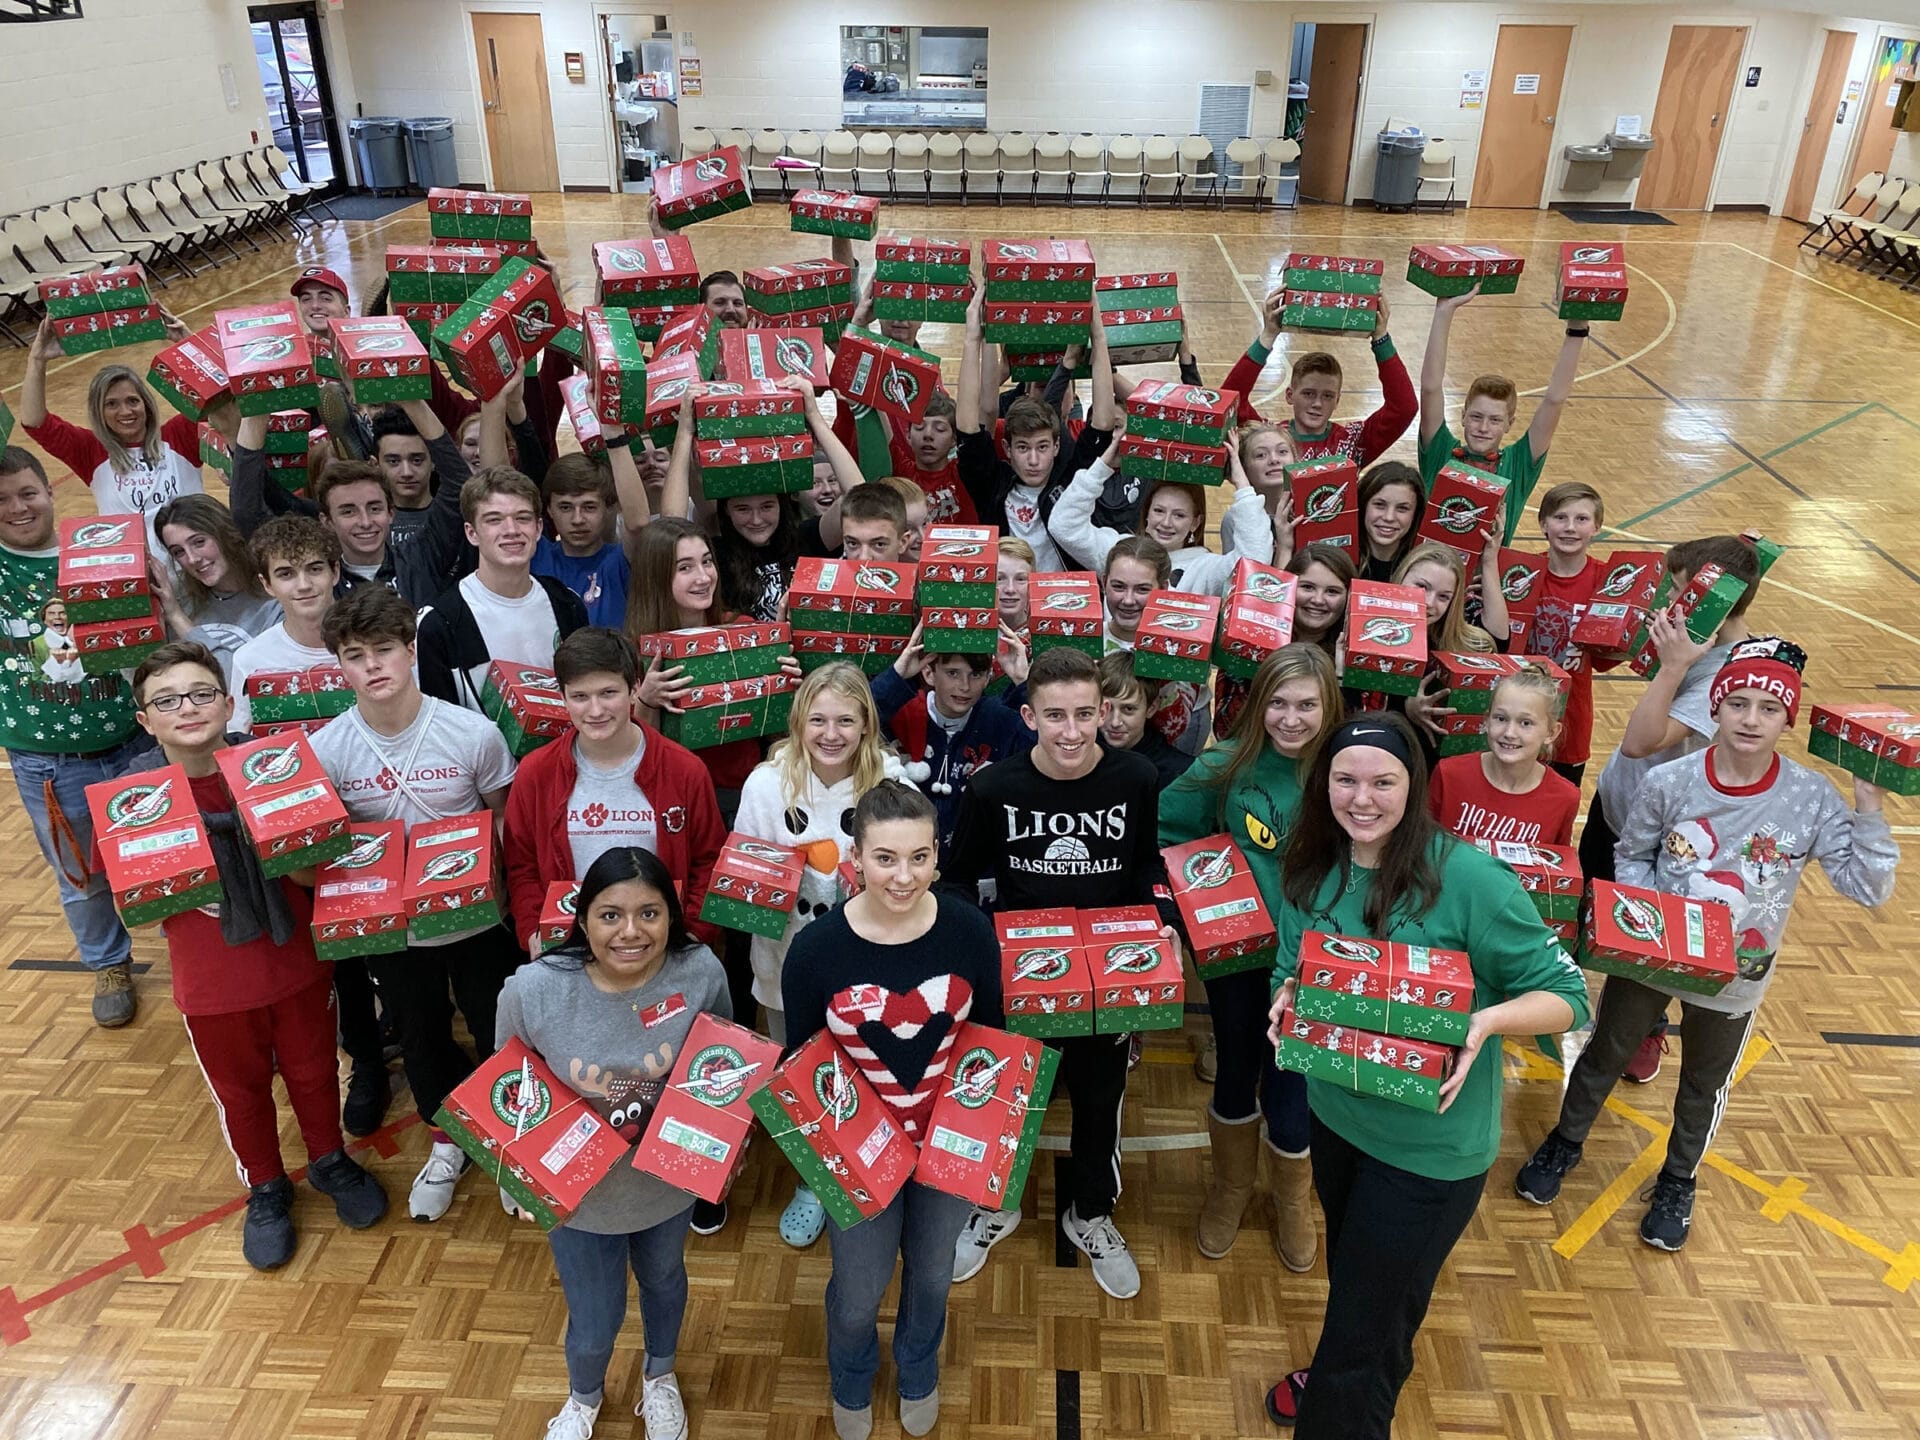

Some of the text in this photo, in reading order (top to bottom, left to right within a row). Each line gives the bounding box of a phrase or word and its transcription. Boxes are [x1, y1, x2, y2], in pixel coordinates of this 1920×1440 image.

[1711, 673, 1795, 711] CAT-MAS
[406, 767, 459, 781] LIONS
[1003, 801, 1127, 842] LIONS
[1008, 854, 1122, 876] BASKETBALL
[350, 881, 369, 891] Girl
[690, 1046, 742, 1081] Samaritan's Purse
[818, 1063, 835, 1076] Purse
[954, 1048, 996, 1086] Samaritan's Purse
[529, 1079, 541, 1115] OPERATION
[541, 1086, 551, 1102] Child
[706, 1082, 742, 1097] OPERATION
[723, 1090, 738, 1104] Child
[492, 1072, 522, 1126] Samaritan's Purse
[566, 1130, 586, 1148] Girl
[689, 1134, 710, 1152] BOY
[873, 1131, 884, 1149] Girl
[955, 1141, 969, 1154] BOY
